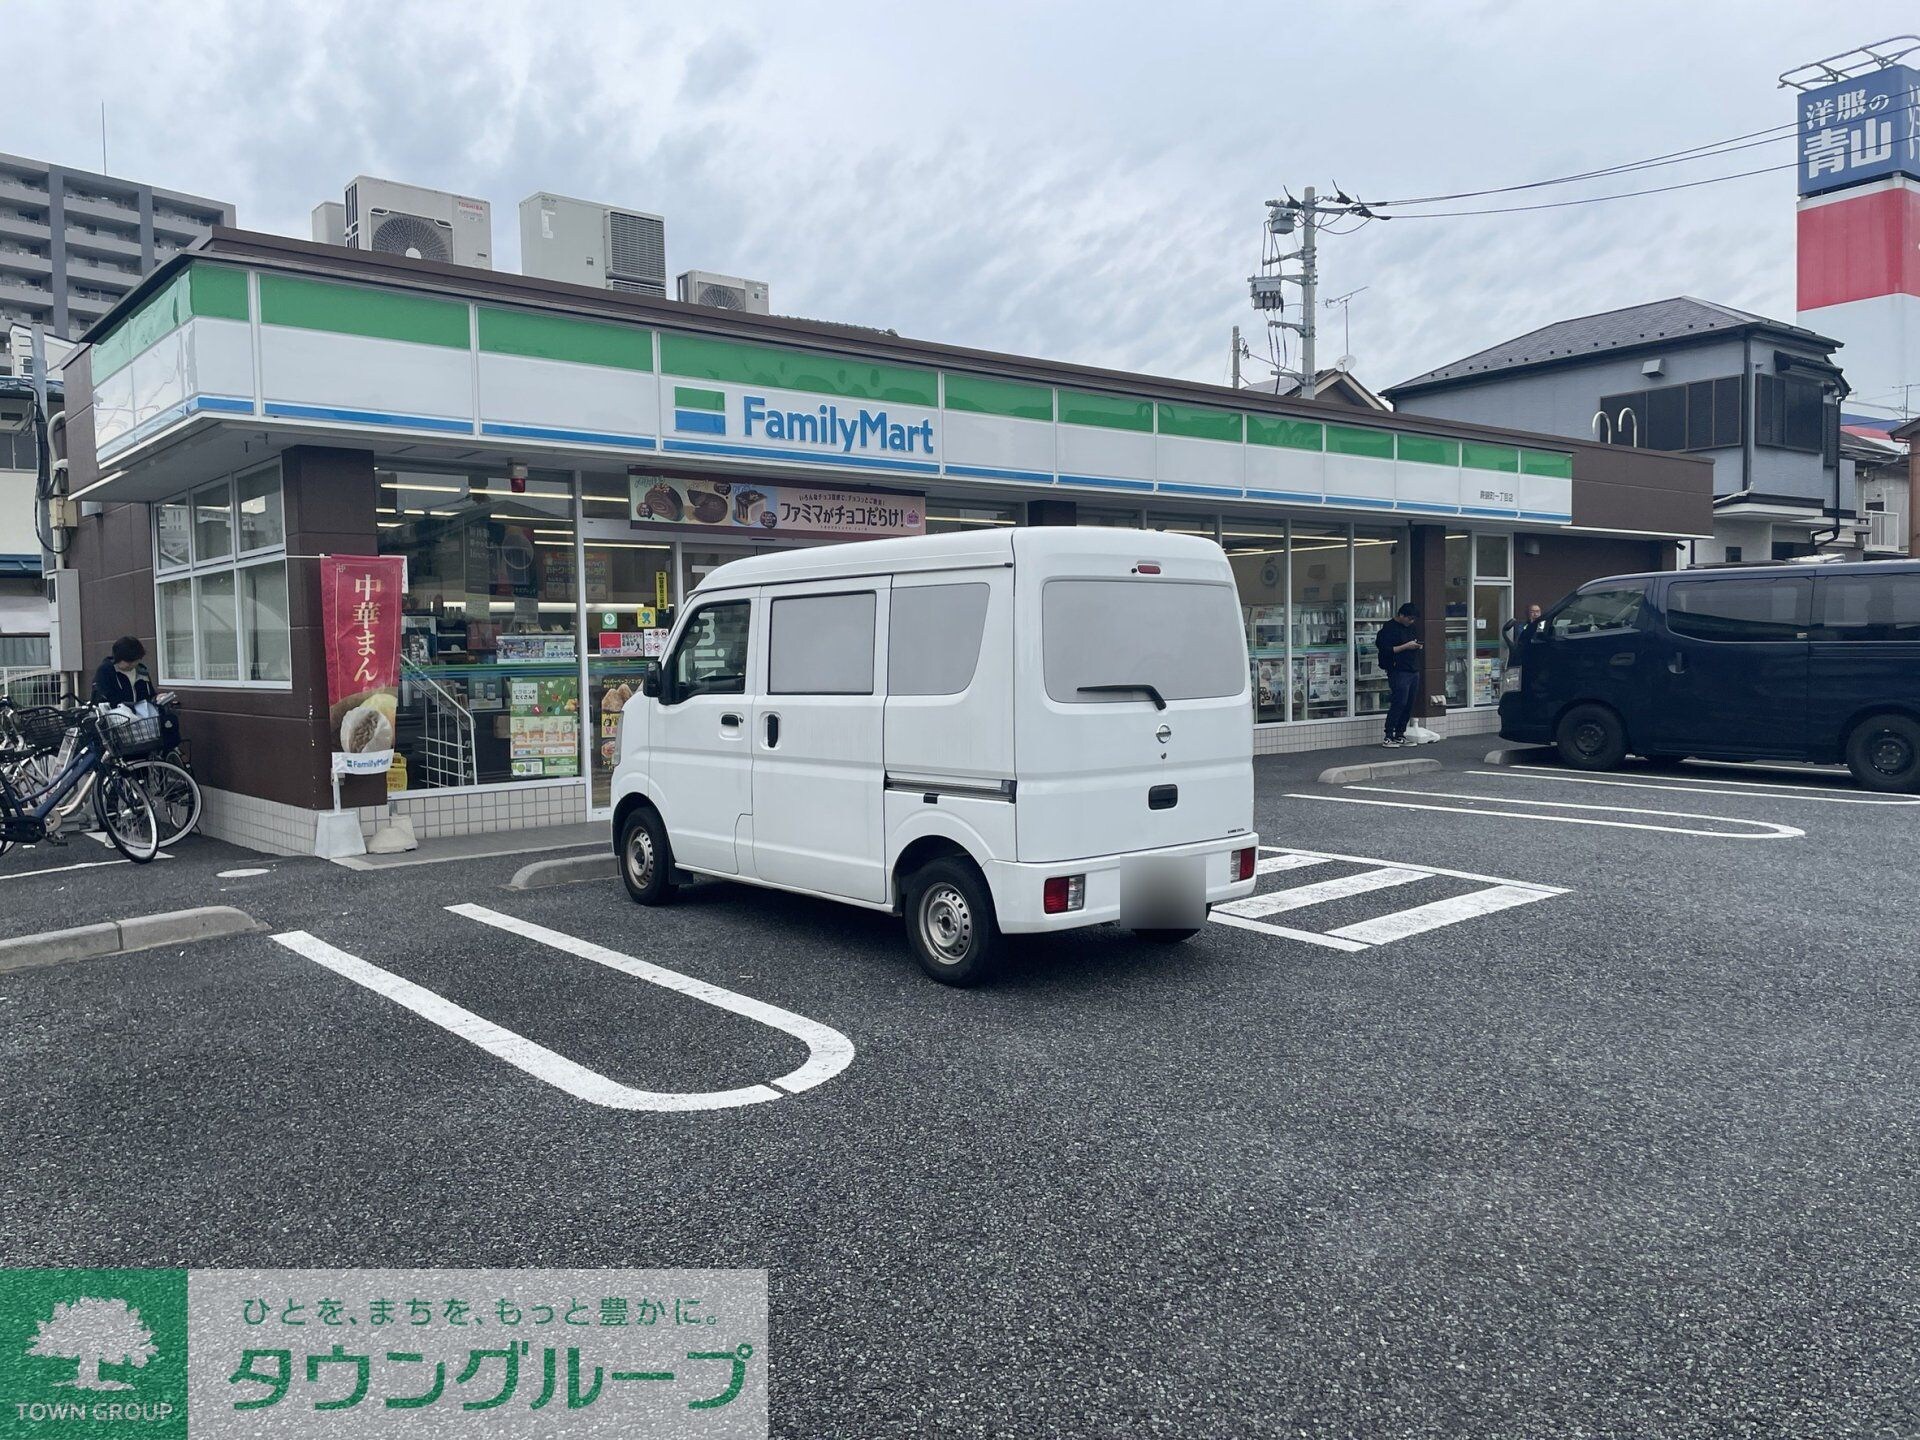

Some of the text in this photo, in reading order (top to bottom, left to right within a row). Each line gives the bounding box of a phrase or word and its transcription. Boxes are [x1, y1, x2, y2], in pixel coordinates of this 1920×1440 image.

[1805, 88, 1889, 130] 洋服の
[1804, 118, 1892, 179] 青山
[743, 395, 935, 454] FamilyMart
[779, 501, 905, 529] ファミマがチョコだらけ!
[352, 573, 383, 684] 中華まん
